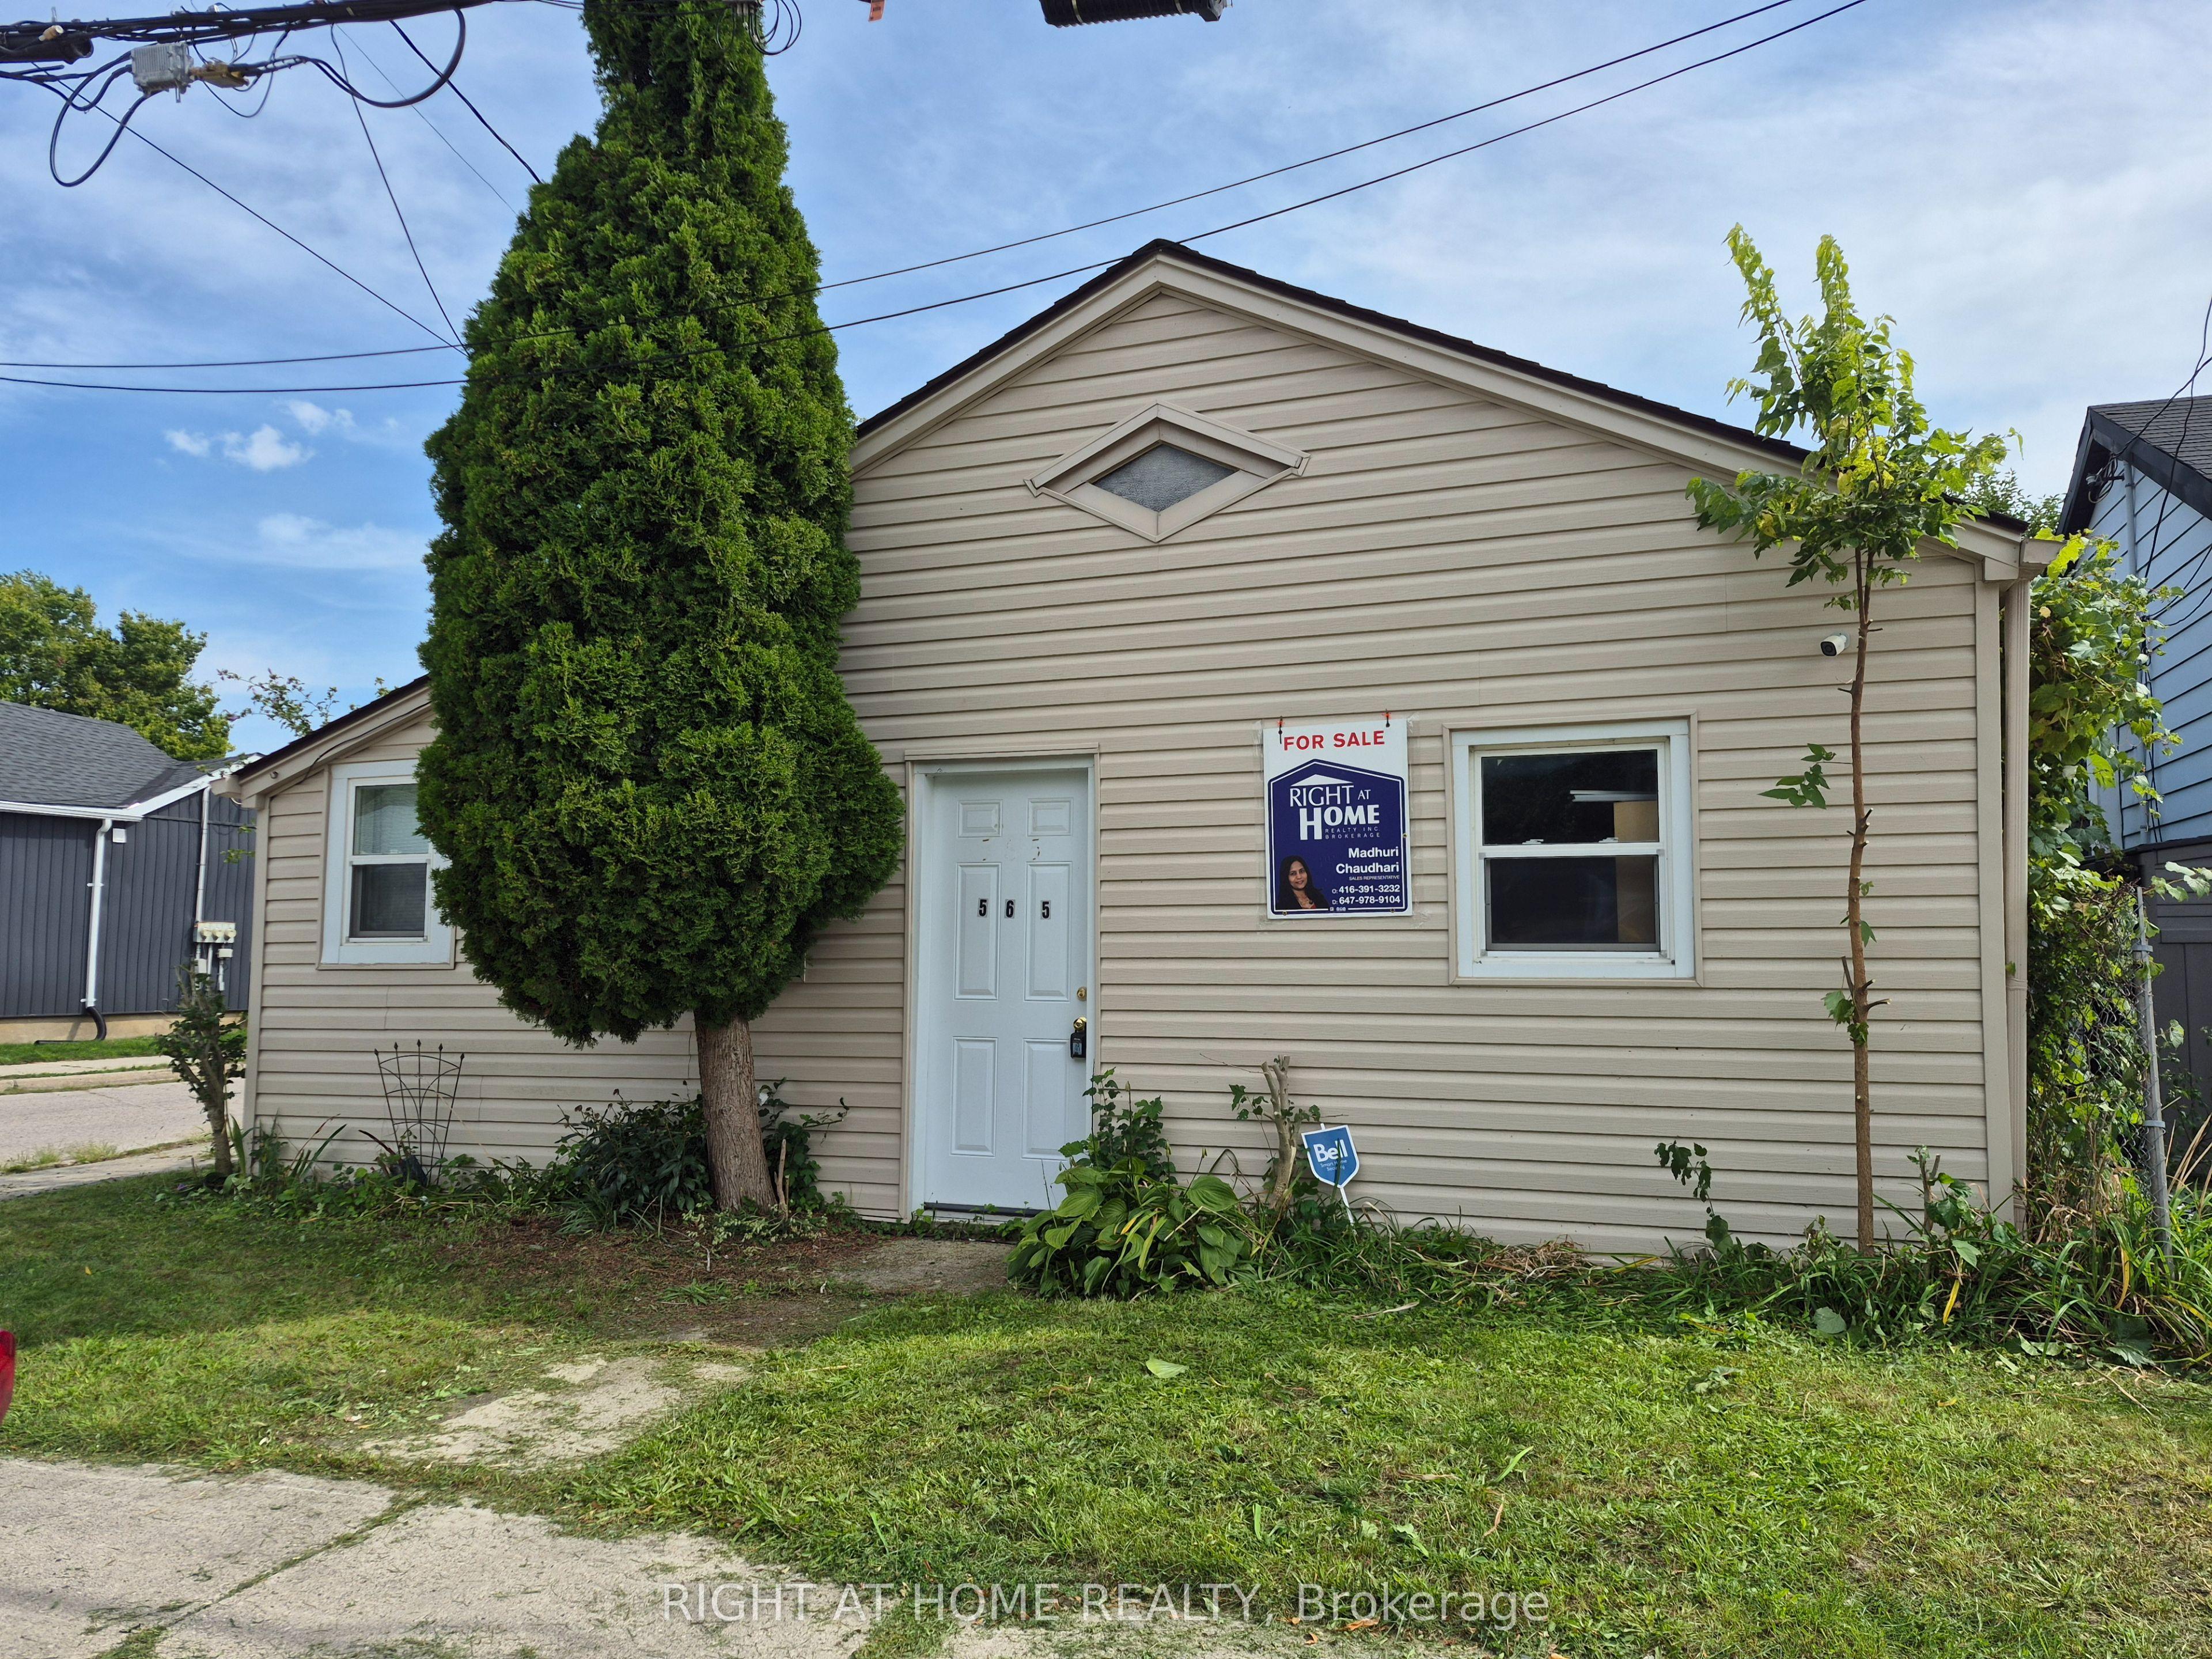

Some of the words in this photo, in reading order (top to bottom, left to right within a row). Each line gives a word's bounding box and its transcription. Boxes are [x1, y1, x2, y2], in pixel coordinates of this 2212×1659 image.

[1283, 735, 1324, 751] FOR
[1334, 730, 1385, 748] SALE
[1290, 785, 1354, 806] RIGHT
[1358, 789, 1371, 800] AT
[1300, 804, 1380, 840] HOME
[1348, 846, 1399, 858] Madhuri
[1336, 862, 1399, 874] Chaudhari
[1339, 884, 1400, 893] 416-391-3232
[1339, 896, 1400, 904] 647-978-9104
[1313, 1139, 1349, 1162] Bell
